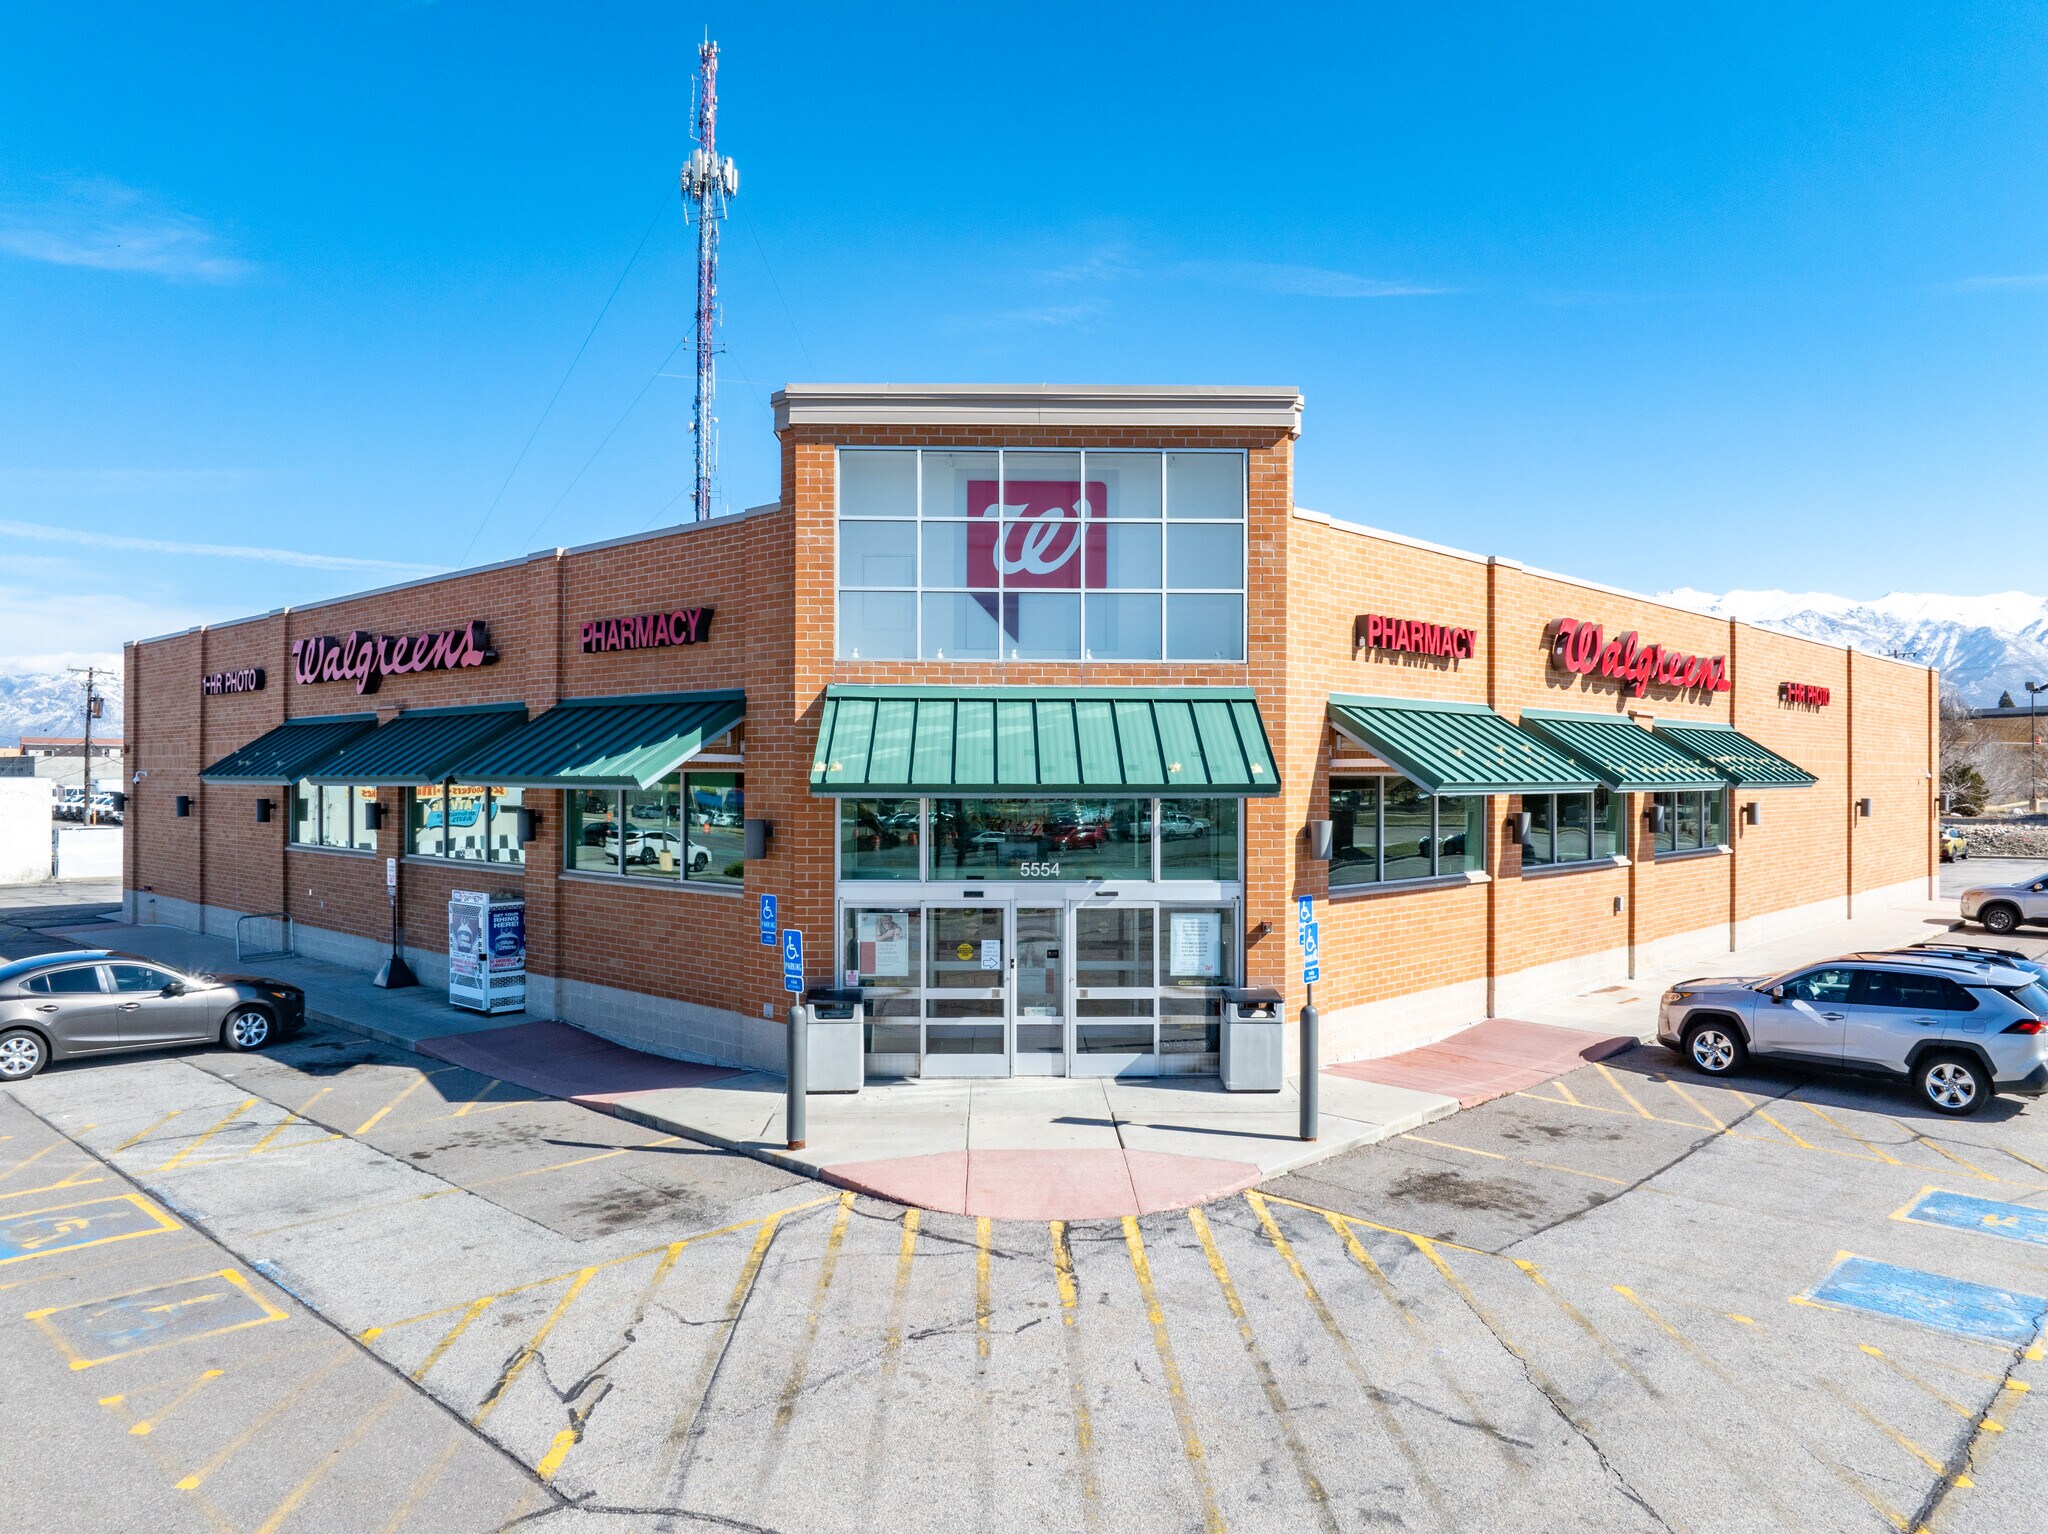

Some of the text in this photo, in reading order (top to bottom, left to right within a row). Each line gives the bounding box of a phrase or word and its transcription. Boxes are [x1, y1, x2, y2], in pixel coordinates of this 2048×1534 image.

[580, 607, 703, 653] PHARMACY
[1367, 613, 1478, 660] PHARMACY
[292, 619, 486, 695] Walgreens
[1556, 617, 1732, 698] Walgreens
[202, 668, 257, 696] 1-HR PHOTO
[1787, 681, 1830, 707] 1-HR PHOTO
[1020, 862, 1061, 877] 5554
[493, 921, 519, 929] HERE!
[785, 961, 802, 972] PARKING
